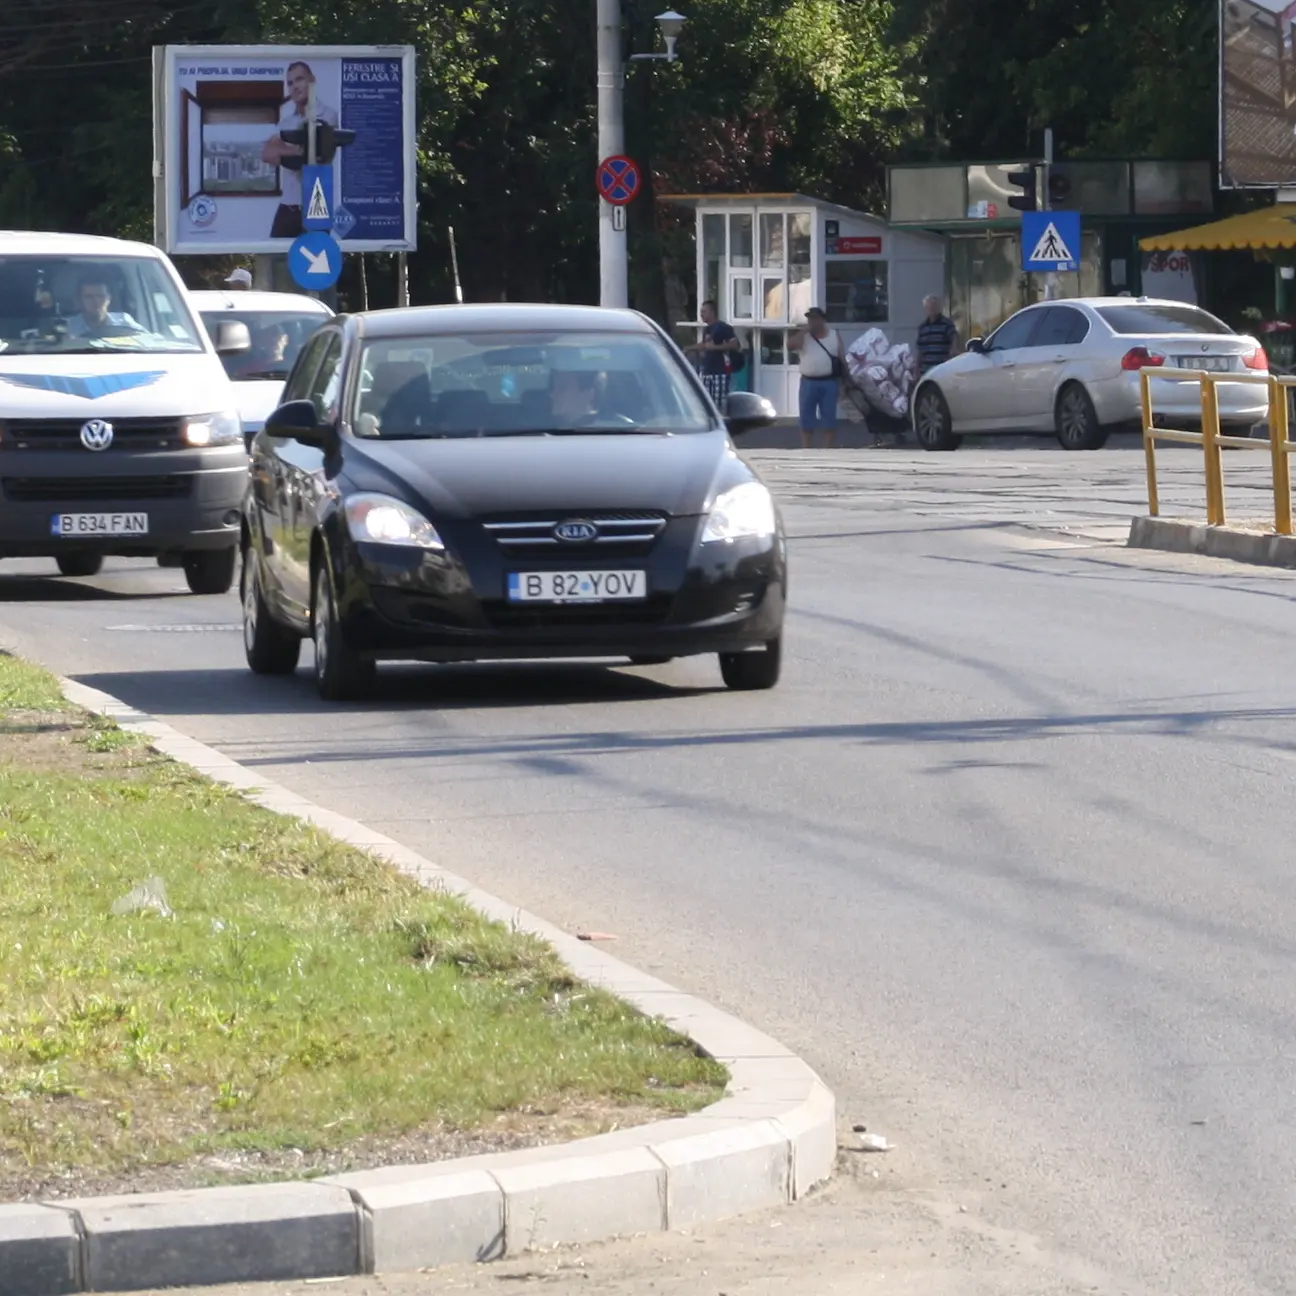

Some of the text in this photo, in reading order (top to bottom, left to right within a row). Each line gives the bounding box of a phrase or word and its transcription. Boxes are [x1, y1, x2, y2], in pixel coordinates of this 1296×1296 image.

[343, 63, 385, 73] FERESTRE
[360, 72, 390, 82] CLASA
[62, 514, 145, 532] B 634 FAN
[561, 525, 590, 537] KIA
[526, 573, 636, 597] B 82 YOV
